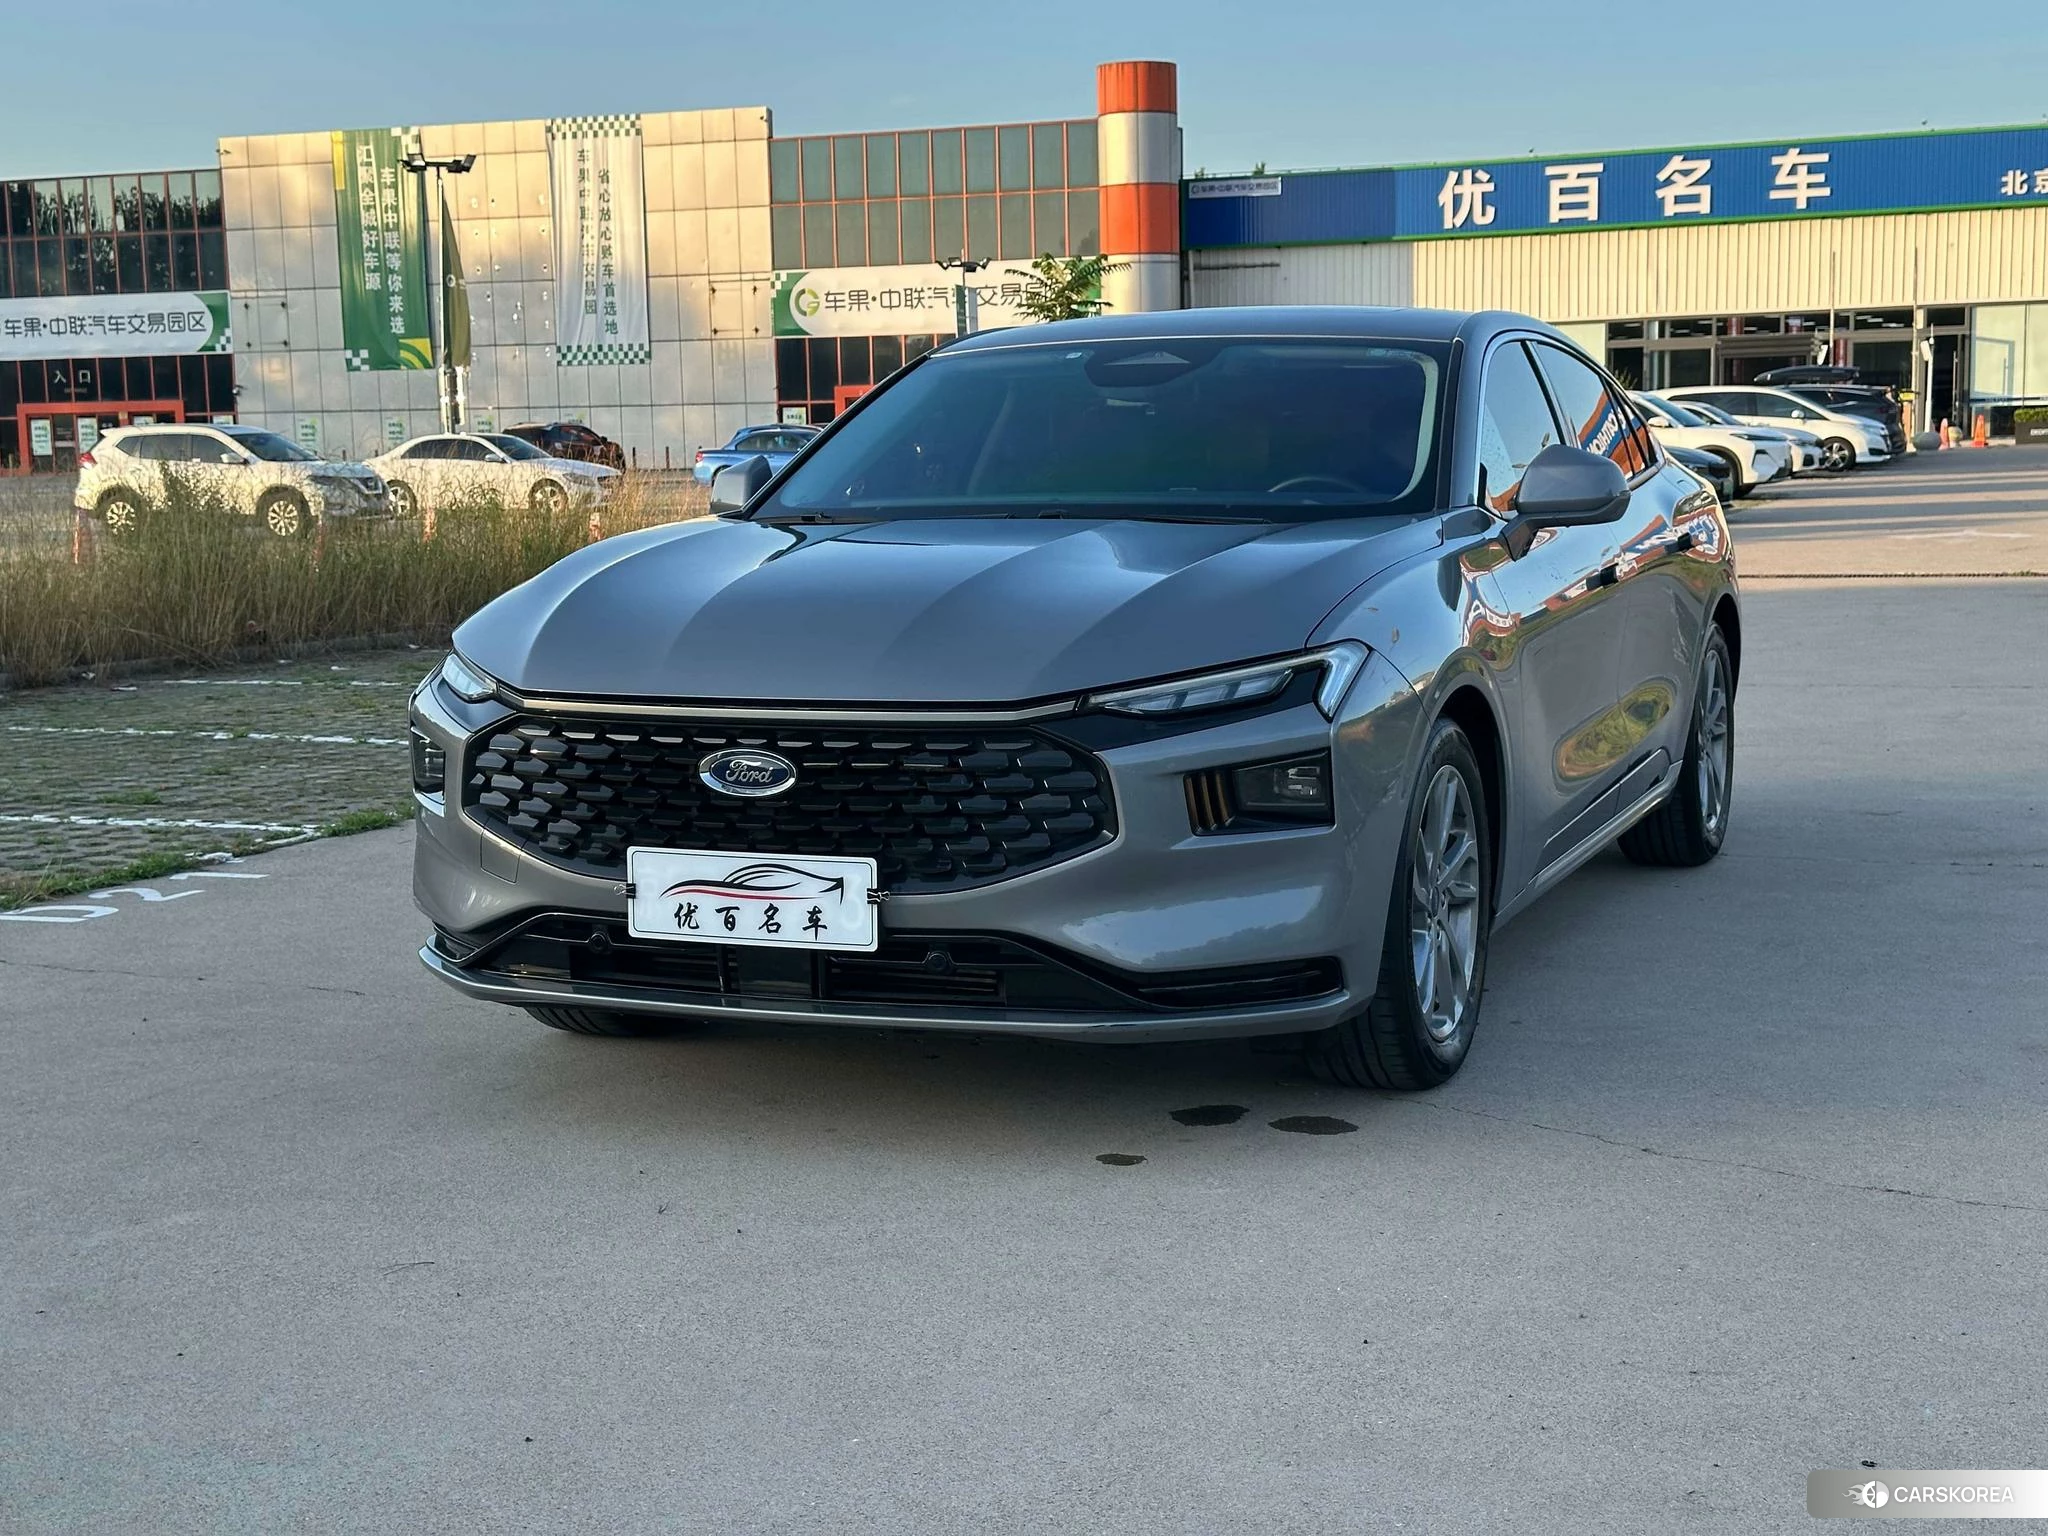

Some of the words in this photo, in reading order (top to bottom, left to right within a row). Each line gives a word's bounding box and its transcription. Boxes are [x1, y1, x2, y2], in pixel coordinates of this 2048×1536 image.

[1438, 147, 1831, 229] 优百名车
[380, 166, 405, 334] 车果中联等你来选
[53, 369, 91, 384] 入口
[725, 759, 773, 783] Ford
[674, 902, 828, 941] 优百名车
